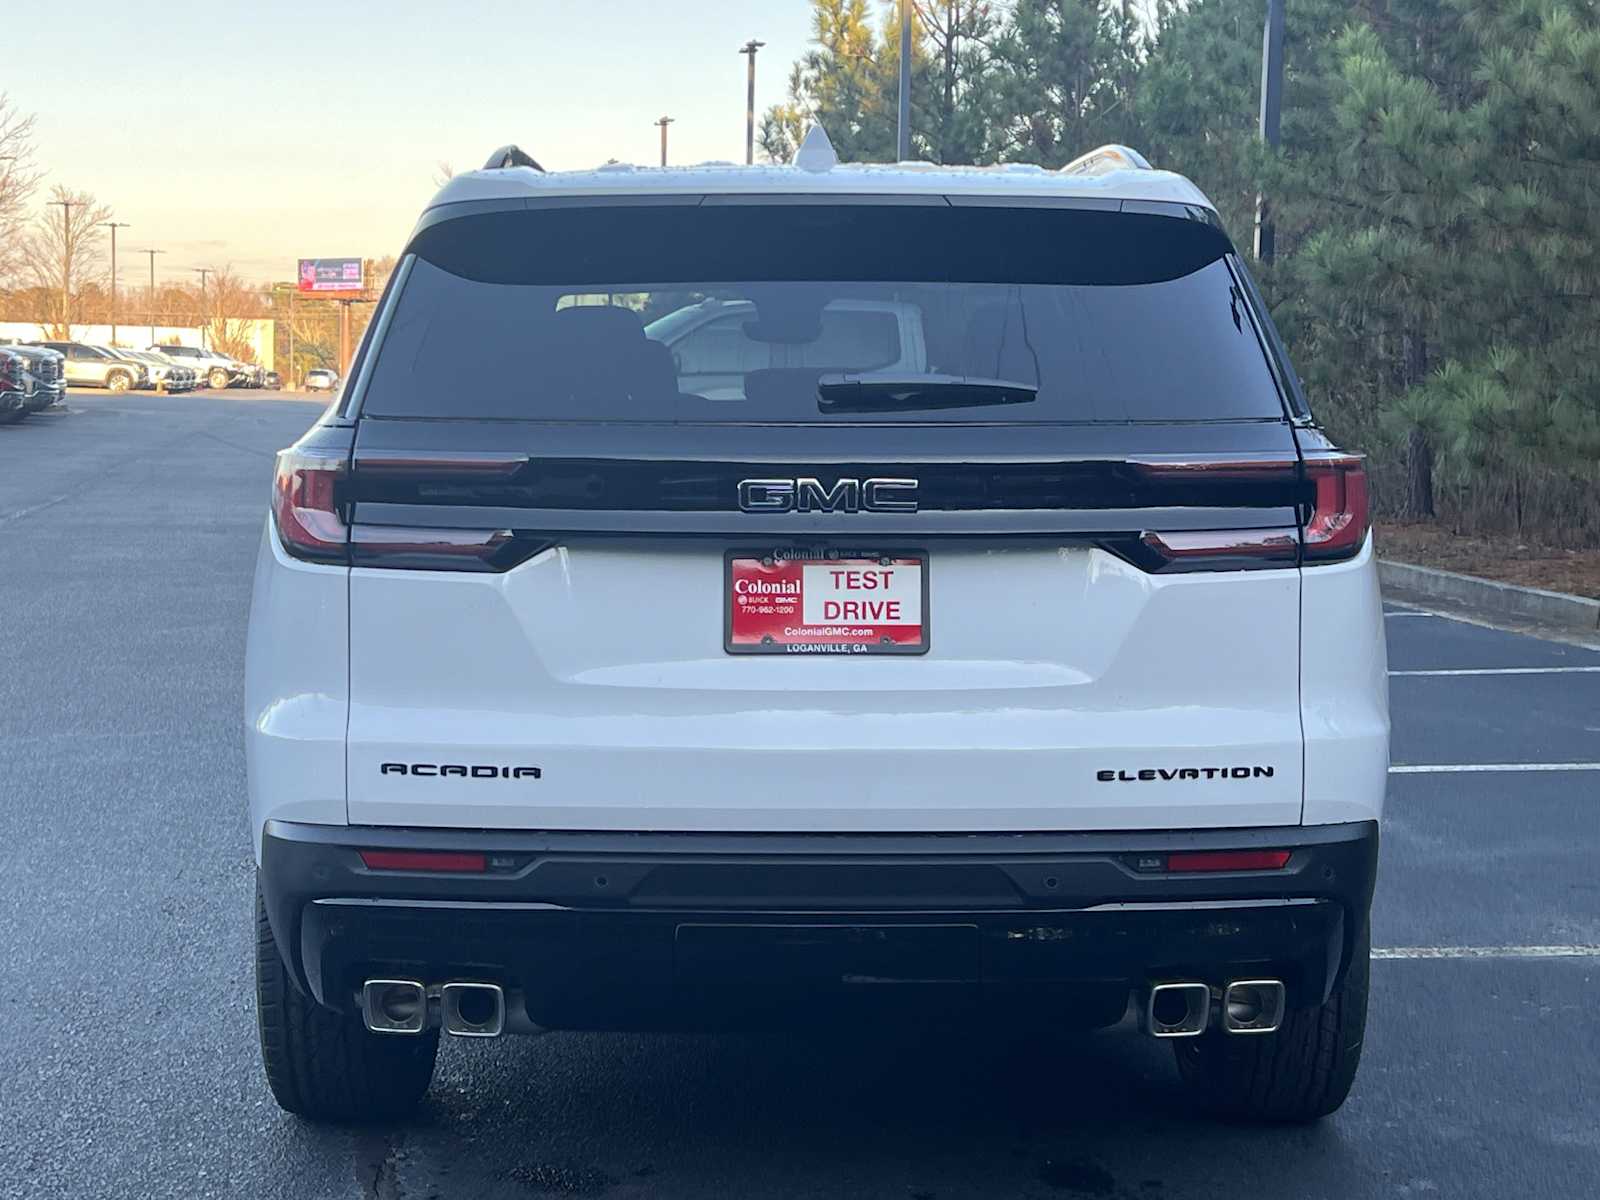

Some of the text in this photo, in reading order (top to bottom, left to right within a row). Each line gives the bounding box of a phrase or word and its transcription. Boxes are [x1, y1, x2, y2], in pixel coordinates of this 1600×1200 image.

[737, 478, 919, 513] GMC
[735, 579, 801, 594] Colonial
[830, 571, 894, 590] TEST
[824, 601, 901, 620] DRIVE
[784, 627, 874, 636] ColonialGMC.com
[786, 644, 868, 654] LOGANVILLE, GA
[381, 763, 542, 779] ACADIA
[1097, 766, 1275, 782] ELEVATION
